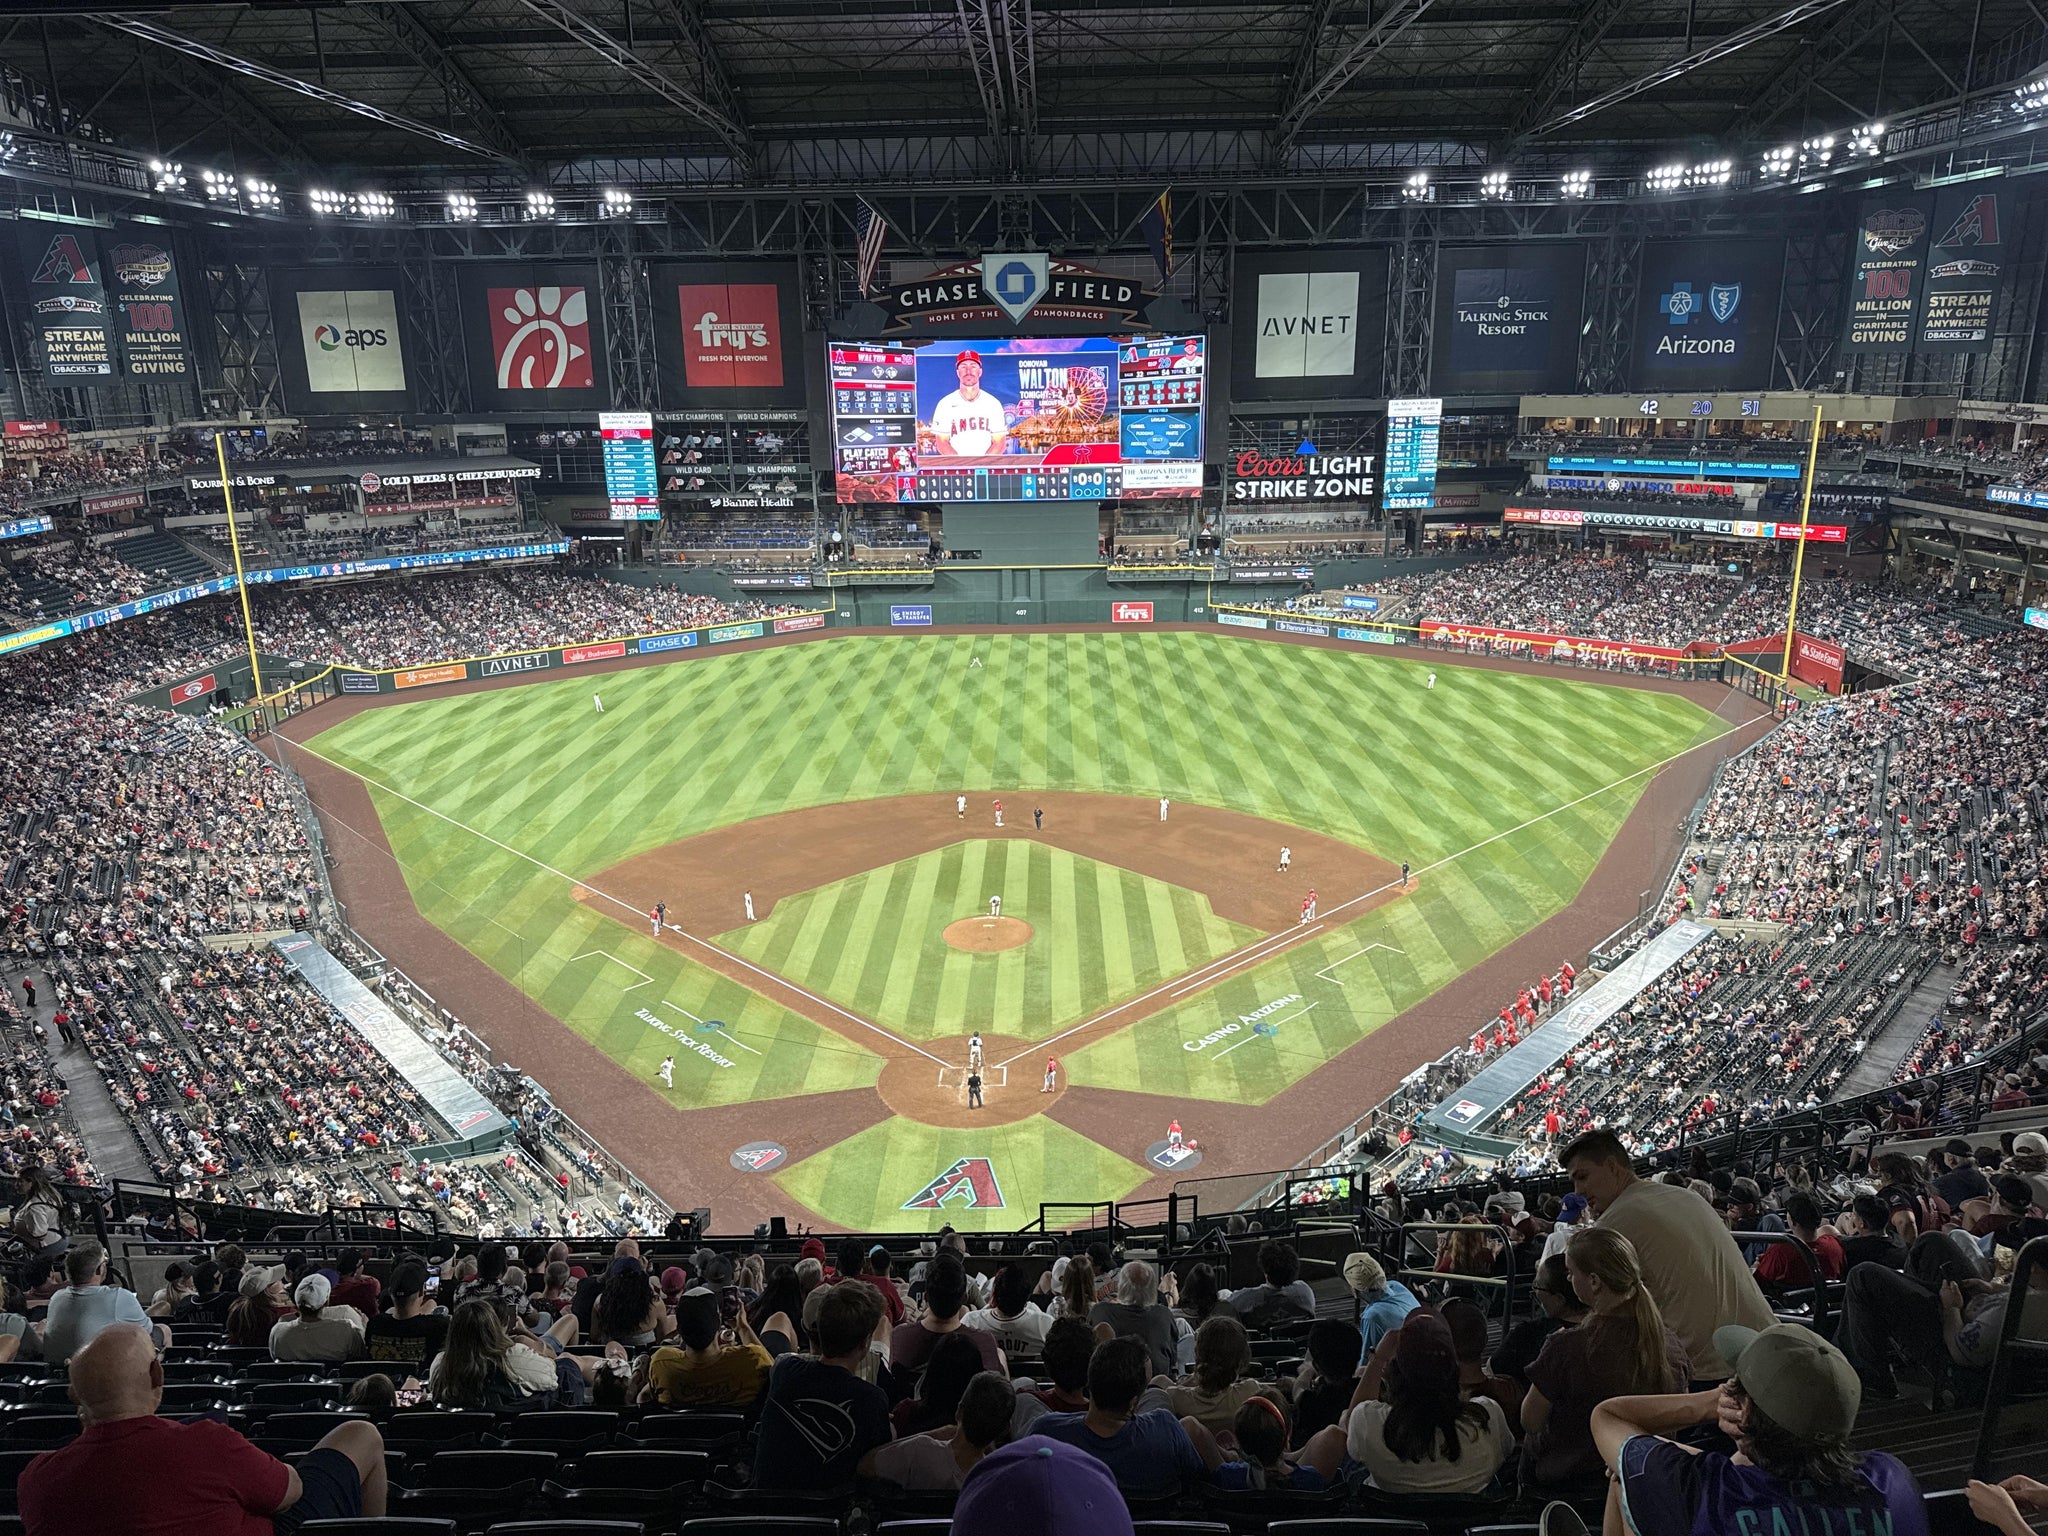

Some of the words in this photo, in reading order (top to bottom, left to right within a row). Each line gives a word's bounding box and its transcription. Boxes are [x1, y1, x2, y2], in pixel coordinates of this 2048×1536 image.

[1862, 260, 1918, 268] CELEBRATING
[1858, 270, 1911, 298] $100
[900, 283, 977, 306] CHASE
[1055, 282, 1132, 302] FIELD
[1856, 300, 1912, 311] MILLION
[1929, 295, 1992, 307] STREAM
[119, 304, 174, 330] $100
[930, 312, 959, 322] HOME
[963, 312, 976, 320] OF
[1034, 310, 1104, 320] DIAMONDBACKS
[1458, 308, 1510, 322] TALKING
[1514, 308, 1548, 322] STICK
[1928, 309, 1953, 318] ANY
[1956, 308, 1988, 316] GAME
[1263, 315, 1350, 337] AVNET
[1926, 319, 1987, 328] ANYWHERE
[694, 312, 770, 350] fry's
[1478, 324, 1526, 336] RESORT
[44, 331, 104, 342] STREAM
[126, 333, 180, 343] MILLION
[344, 328, 387, 350] aps
[1852, 331, 1906, 342] GIVING
[1656, 334, 1735, 354] Arizona
[858, 354, 886, 362] WALTON
[1149, 348, 1170, 356] KELLY
[132, 362, 186, 374] GIVING
[1019, 368, 1068, 389] WALTON
[1020, 391, 1051, 400] TONIGHT:
[1640, 400, 1658, 414] 42
[1690, 401, 1712, 415] 20
[1741, 400, 1760, 416] 51
[19, 423, 47, 431] Honeywell
[844, 448, 862, 458] PLAY
[865, 448, 888, 456] CATCH
[1236, 450, 1305, 476] Coors
[1310, 456, 1375, 474] LIGHT
[236, 476, 246, 486] &
[247, 476, 275, 484] BONES
[383, 476, 410, 486] COLD
[413, 474, 446, 484] BEERS
[448, 474, 454, 482] &
[456, 468, 541, 481] CHEESEBURGERS
[1026, 477, 1032, 485] 5
[1078, 473, 1088, 486] 0
[1093, 473, 1102, 486] 0
[1235, 480, 1307, 498] STRIKE
[1314, 478, 1374, 496] ZONE
[1548, 478, 1606, 489] ESTRELLA
[1624, 480, 1672, 492] JALISCO
[1676, 482, 1734, 495] CANTINA
[1991, 490, 2007, 500] 8:04
[2008, 491, 2019, 502] PM
[410, 502, 444, 510] Neighborhood
[722, 498, 760, 507] Banner
[761, 498, 794, 507] Health
[1390, 498, 1428, 508] $20,934
[356, 564, 390, 572] THOMPSON
[1116, 605, 1148, 620] fry's
[1286, 624, 1306, 632] Banner
[1307, 626, 1325, 634] Health
[644, 636, 673, 648] CHASE
[1344, 630, 1362, 640] COX
[1368, 632, 1388, 642] COX
[1457, 628, 1532, 650] StatFarm
[588, 649, 619, 658] Budweiser
[490, 656, 541, 672] AVNET
[418, 672, 436, 680] Dignity
[1182, 1023, 1242, 1052] CASINO
[1238, 994, 1303, 1026] ARIZONA
[634, 1008, 673, 1033] TALKING
[668, 1030, 698, 1049] STICK
[694, 1043, 736, 1068] RESORT
[998, 1339, 1028, 1352] ROUT
